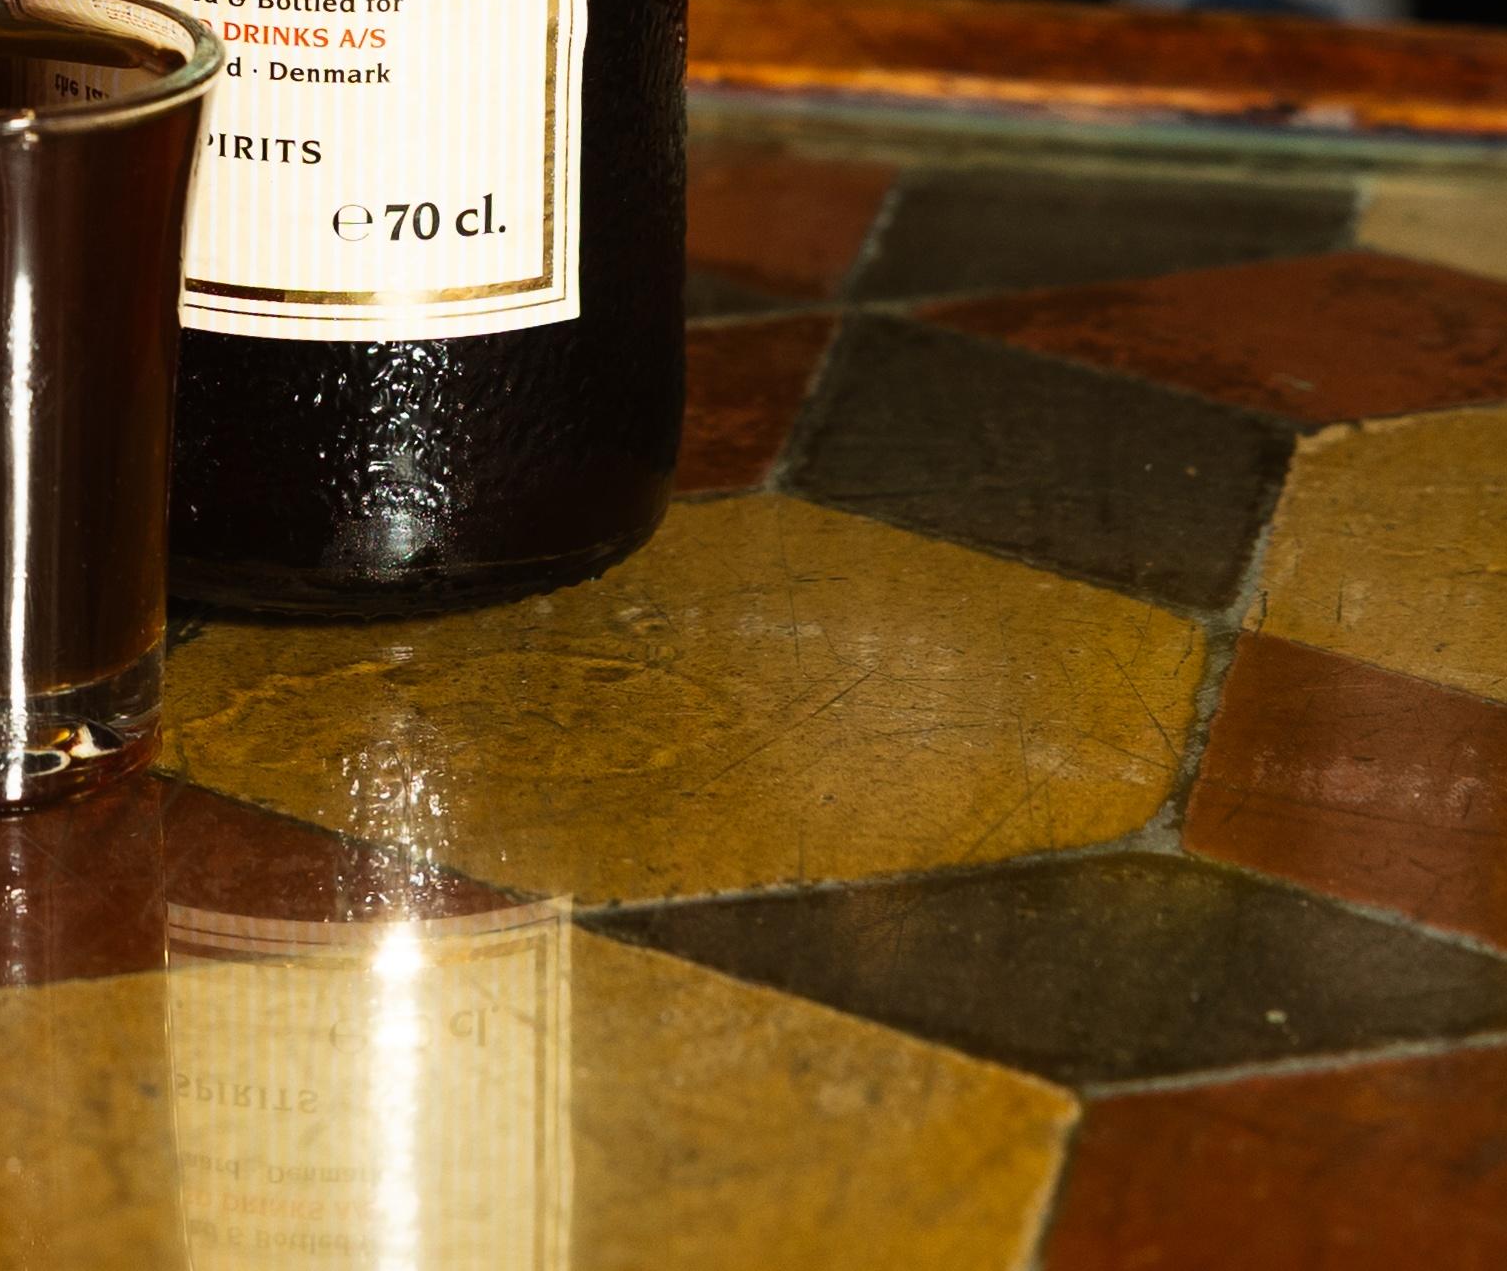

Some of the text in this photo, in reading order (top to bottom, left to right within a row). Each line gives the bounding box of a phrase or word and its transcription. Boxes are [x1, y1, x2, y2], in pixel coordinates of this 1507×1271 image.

[224, 21, 329, 47] DRINKS
[340, 28, 385, 48] A/S
[269, 62, 390, 84] Denmark
[207, 133, 321, 164] IRITS
[385, 202, 440, 241] 70
[455, 193, 506, 237] cl.
